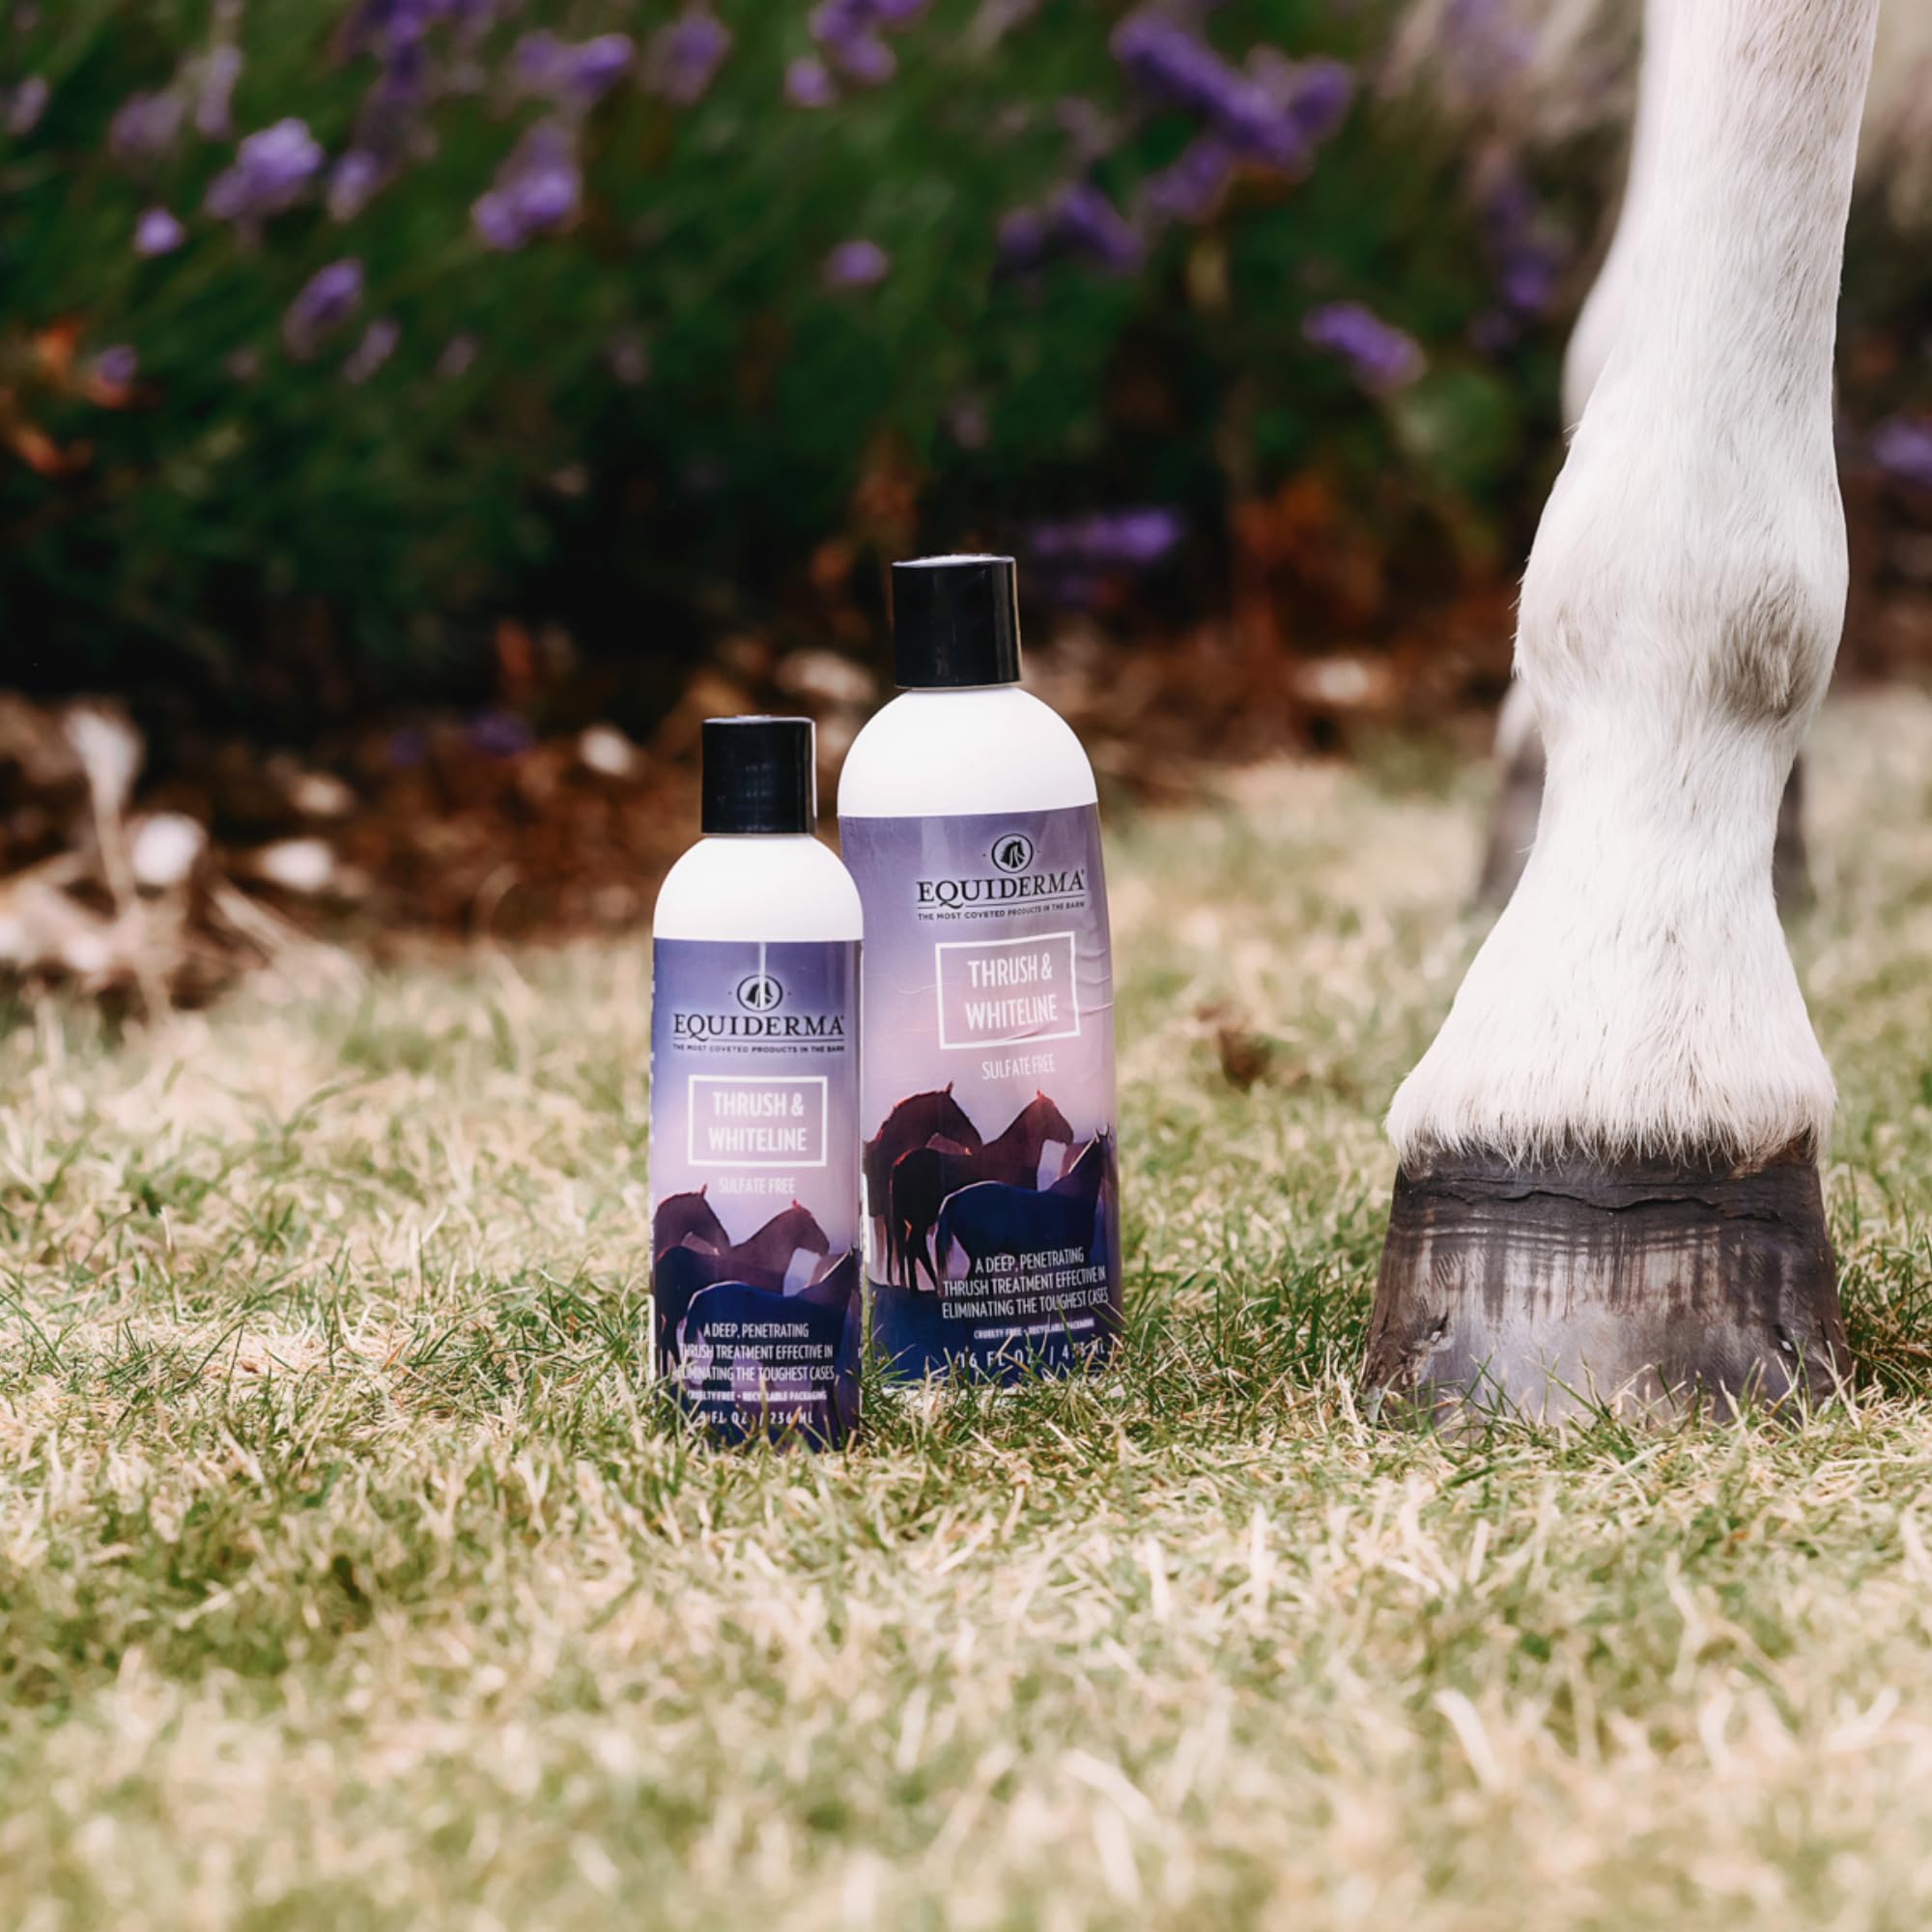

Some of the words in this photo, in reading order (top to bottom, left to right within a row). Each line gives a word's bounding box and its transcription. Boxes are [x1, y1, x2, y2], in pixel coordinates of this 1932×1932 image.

[917, 869, 1085, 909] EQUIDERMA
[937, 911, 961, 920] MOST
[965, 910, 1005, 919] COVETED
[1008, 905, 1042, 916] PRODUCTS
[1052, 902, 1064, 911] THE
[1065, 900, 1085, 910] BARN
[967, 953, 1037, 988] THRUSH
[1040, 952, 1052, 980] &
[966, 994, 1059, 1030] WHITELINE
[672, 1013, 845, 1042] EQUIDERMA
[981, 1057, 1031, 1080] SULFATE
[1032, 1053, 1055, 1074] FREE
[712, 1092, 787, 1117] THRUSH
[790, 1092, 805, 1118] &
[708, 1127, 808, 1151] WHITELINE
[719, 1178, 765, 1194] SULFATE
[768, 1178, 796, 1194] FREE
[975, 1258, 983, 1275] A
[1020, 1246, 1085, 1269] PENETRATING
[943, 1278, 989, 1298] THRUSH
[991, 1272, 1054, 1295] TREATMENT
[1056, 1266, 1097, 1289] EFFECTIVE
[1098, 1264, 1106, 1281] IN
[942, 1297, 1014, 1320] ELIMINATING
[1016, 1295, 1037, 1315] THE
[1039, 1289, 1088, 1313] TOUGHEST
[1088, 1287, 1109, 1304] CASES
[703, 1323, 711, 1338] A
[742, 1322, 810, 1339] PENETRATING
[716, 1344, 774, 1360] TREATMENT
[776, 1344, 823, 1360] EFFECTIVE
[824, 1344, 833, 1358] IN
[736, 1366, 755, 1381] THE
[757, 1366, 808, 1381] TOUGHEST
[810, 1365, 835, 1380] CASES
